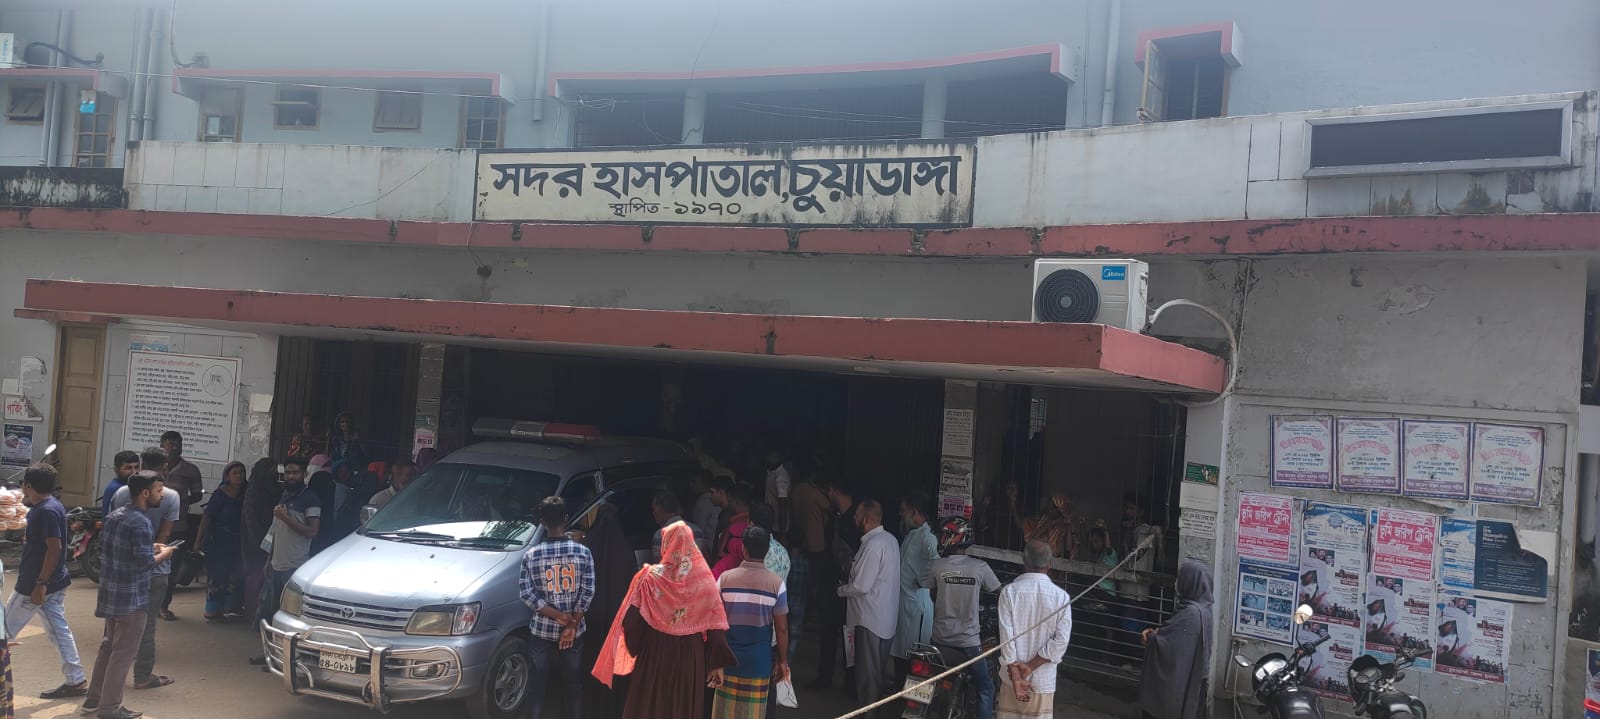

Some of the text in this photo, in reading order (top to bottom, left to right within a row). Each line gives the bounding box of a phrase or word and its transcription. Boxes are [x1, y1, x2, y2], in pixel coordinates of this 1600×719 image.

[490, 162, 586, 199] সদর
[608, 197, 660, 219] স্থাপিত
[673, 201, 742, 217] ১৯৭০
